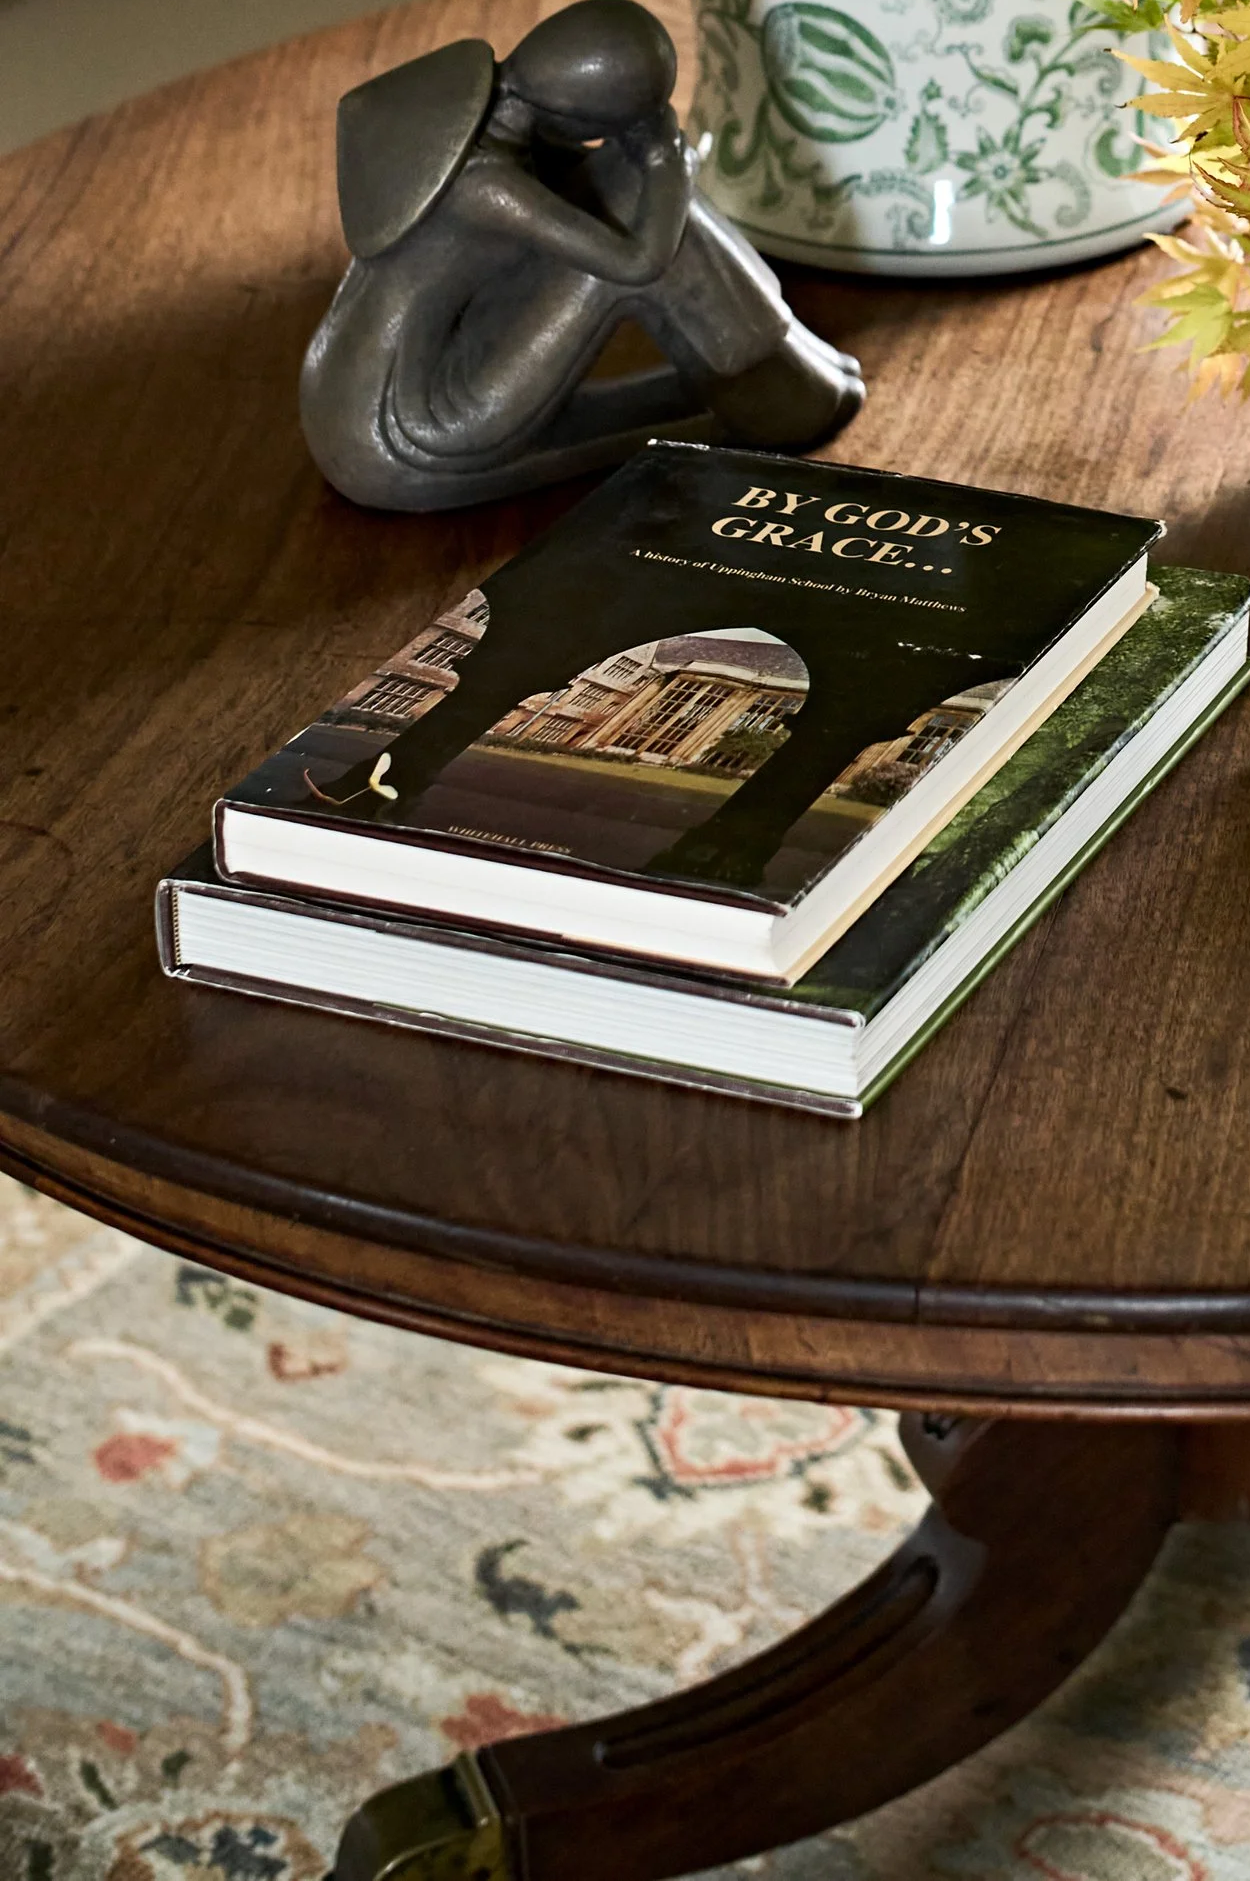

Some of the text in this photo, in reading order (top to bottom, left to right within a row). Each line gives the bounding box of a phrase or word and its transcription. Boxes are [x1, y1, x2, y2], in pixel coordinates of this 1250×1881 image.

[711, 516, 954, 575] GRACE...
[731, 486, 1002, 547] BY GOD'S
[629, 549, 967, 613] A history of Uppingham School by Bryan Matthews
[530, 840, 573, 855] PRESS
